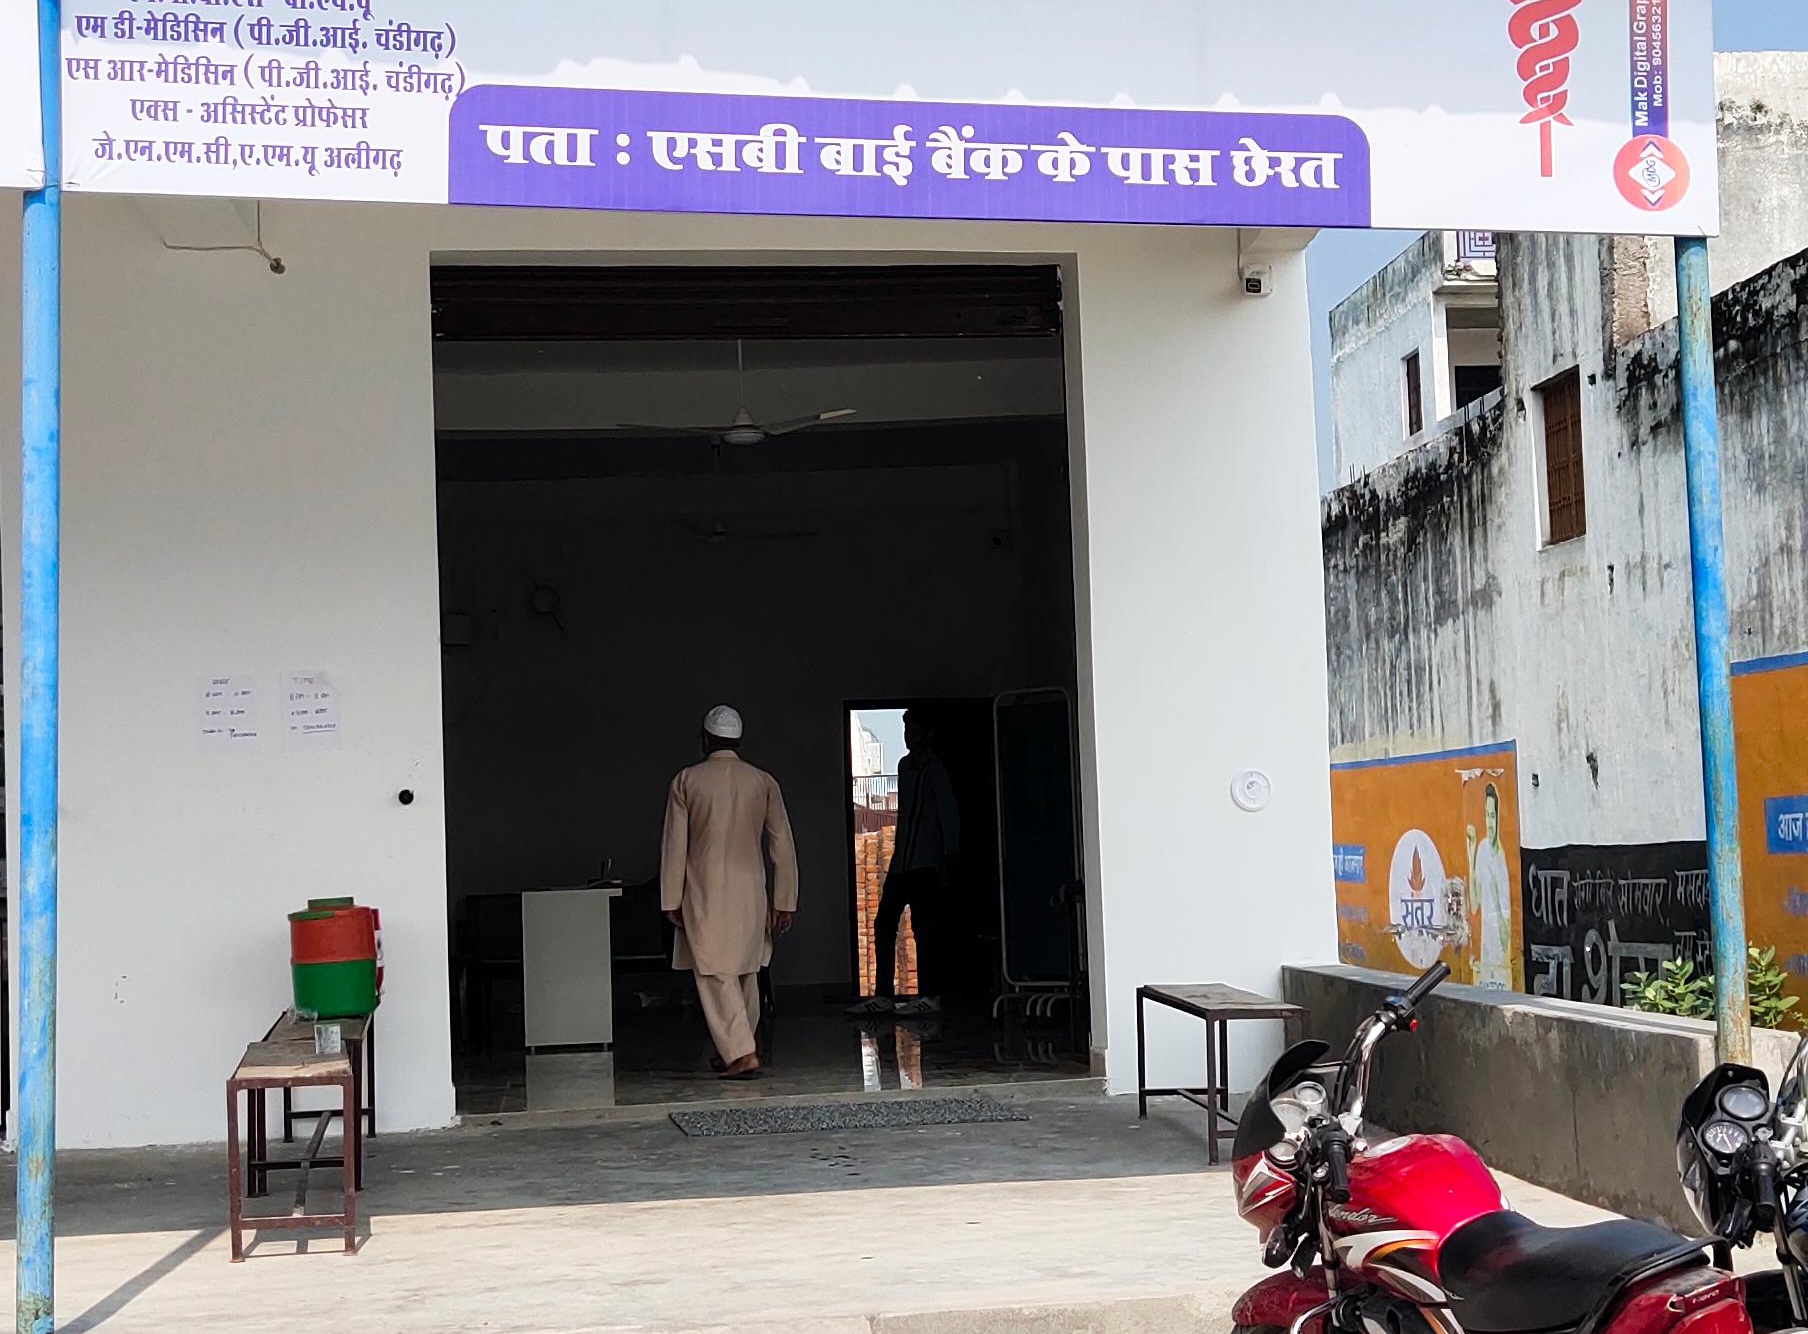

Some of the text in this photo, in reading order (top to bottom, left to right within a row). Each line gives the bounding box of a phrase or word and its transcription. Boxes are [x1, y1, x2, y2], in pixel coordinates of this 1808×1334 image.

[75, 15, 106, 40] एम
[65, 57, 99, 82] एस
[1634, 37, 1650, 88] Digital
[200, 94, 288, 125] असिस्टेंट
[292, 99, 370, 129] प्रोफेसर
[1635, 89, 1648, 127] Mak
[324, 140, 403, 177] अलीगढ़
[478, 123, 600, 167] पता
[646, 123, 806, 174] एसबी
[815, 125, 916, 186] बाई
[925, 125, 1029, 181] बैंक
[1029, 132, 1096, 182] के
[1101, 144, 1220, 186] पास
[1777, 812, 1803, 842] आज
